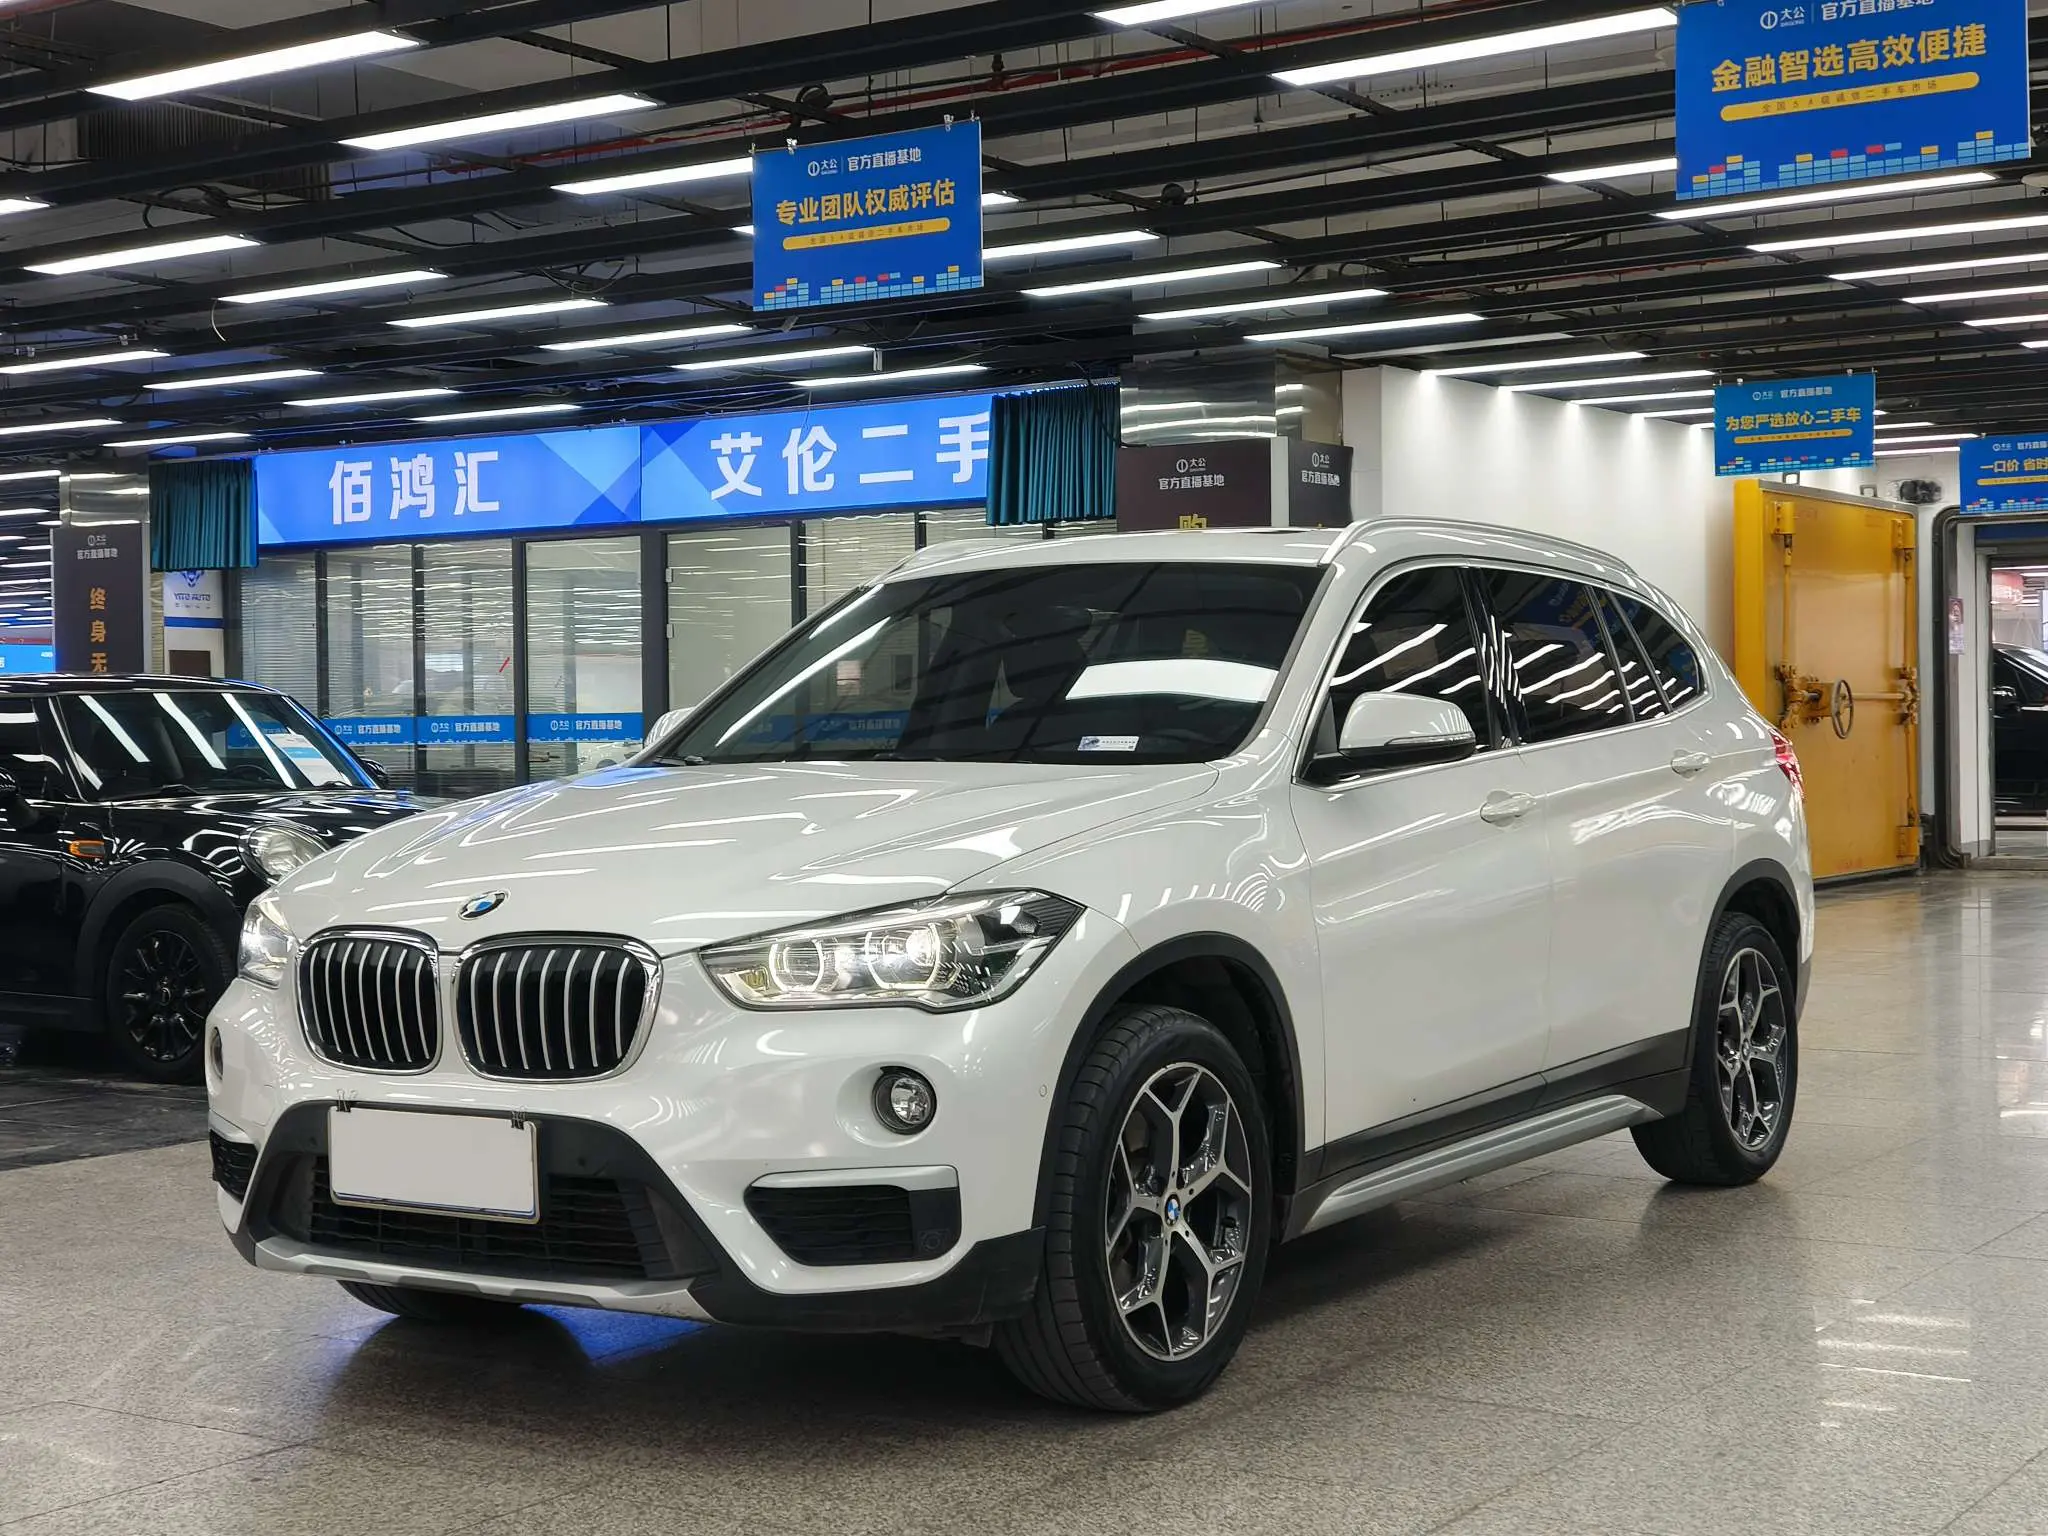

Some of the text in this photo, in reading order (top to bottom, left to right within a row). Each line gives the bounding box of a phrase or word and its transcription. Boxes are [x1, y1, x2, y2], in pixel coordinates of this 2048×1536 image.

[1780, 6, 1805, 20] 大公
[1711, 23, 1987, 93] 金融智选高效便捷
[820, 147, 922, 172] 大公 官方直播基地
[776, 178, 956, 225] 专业团队权威评估
[1726, 407, 1862, 431] 为您严选放心二手车
[710, 411, 990, 500] 艾伦二手
[1190, 457, 1206, 467] 大公
[329, 451, 500, 525] 佰鸿汇
[1158, 474, 1225, 490] 官方直播基地
[1301, 470, 1340, 487] 官方直播基地
[576, 720, 623, 730] 官方直播基地
